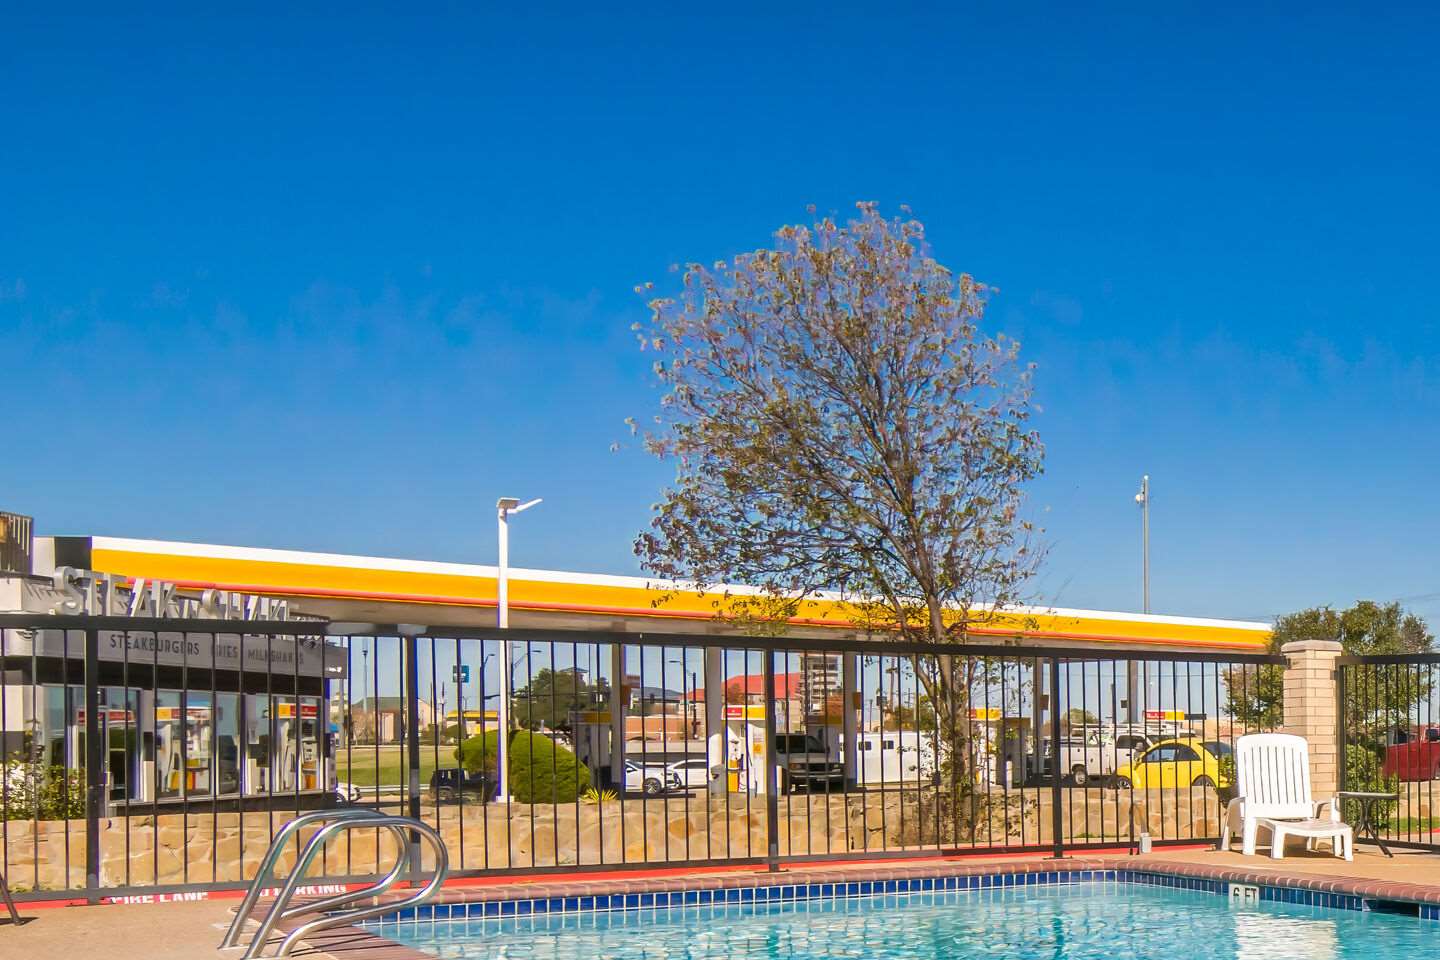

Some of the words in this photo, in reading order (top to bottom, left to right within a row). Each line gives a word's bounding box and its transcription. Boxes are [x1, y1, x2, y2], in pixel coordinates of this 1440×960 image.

[55, 566, 180, 618] STEAK
[212, 643, 239, 659] RIES
[247, 648, 304, 666] MILKSHAKS
[160, 891, 208, 904] LANE
[272, 884, 346, 897] PRKING
